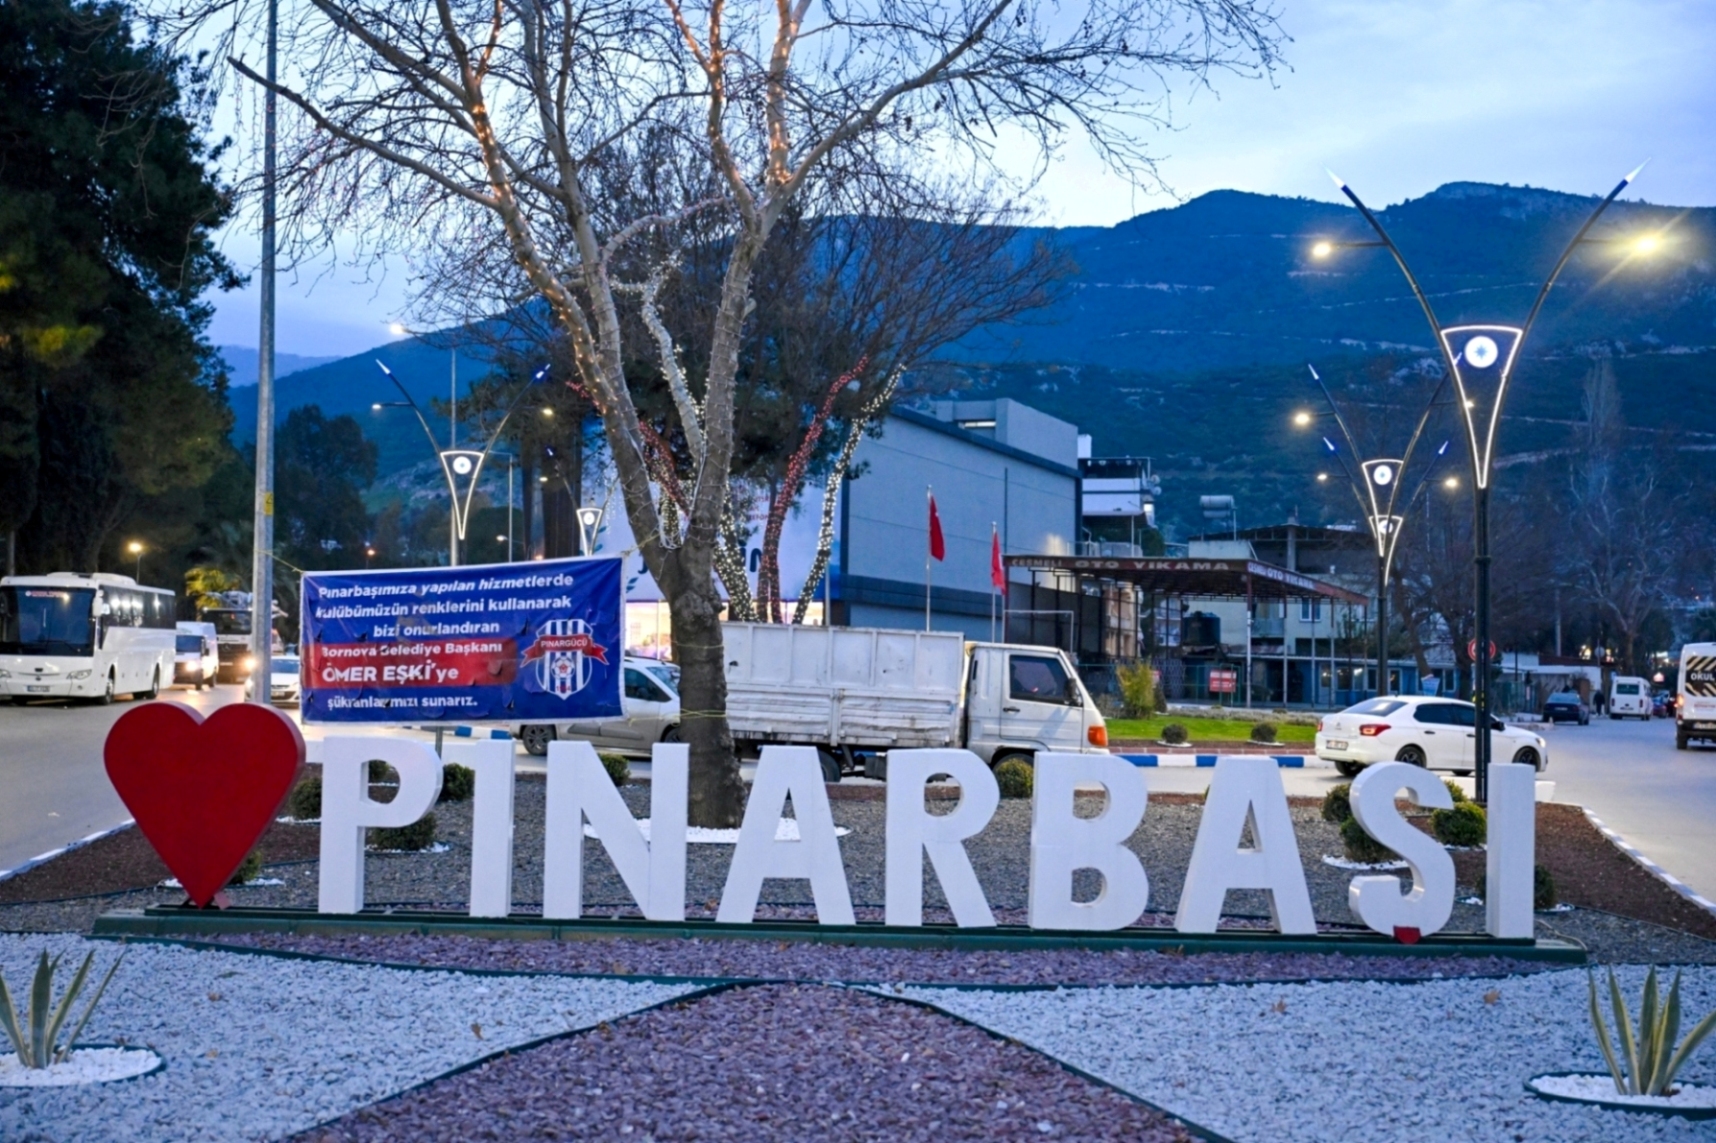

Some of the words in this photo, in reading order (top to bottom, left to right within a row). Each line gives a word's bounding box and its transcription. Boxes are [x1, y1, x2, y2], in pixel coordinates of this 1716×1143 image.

[1075, 561, 1120, 569] OTO
[1133, 561, 1230, 571] YIKAMA
[1267, 568, 1284, 581] OTO
[420, 579, 475, 596] yapılan
[478, 573, 574, 591] hizmetlerde
[315, 602, 408, 619] kulübümüzün
[412, 598, 485, 615] renklerini
[488, 594, 572, 612] kullanarak
[373, 623, 400, 638] bizi
[445, 641, 503, 656] Başkanı
[540, 637, 588, 648] PINARGÜCÜ
[322, 662, 377, 683] ÖMER
[1690, 672, 1715, 682] OKUL
[421, 696, 478, 708] sunarız.
